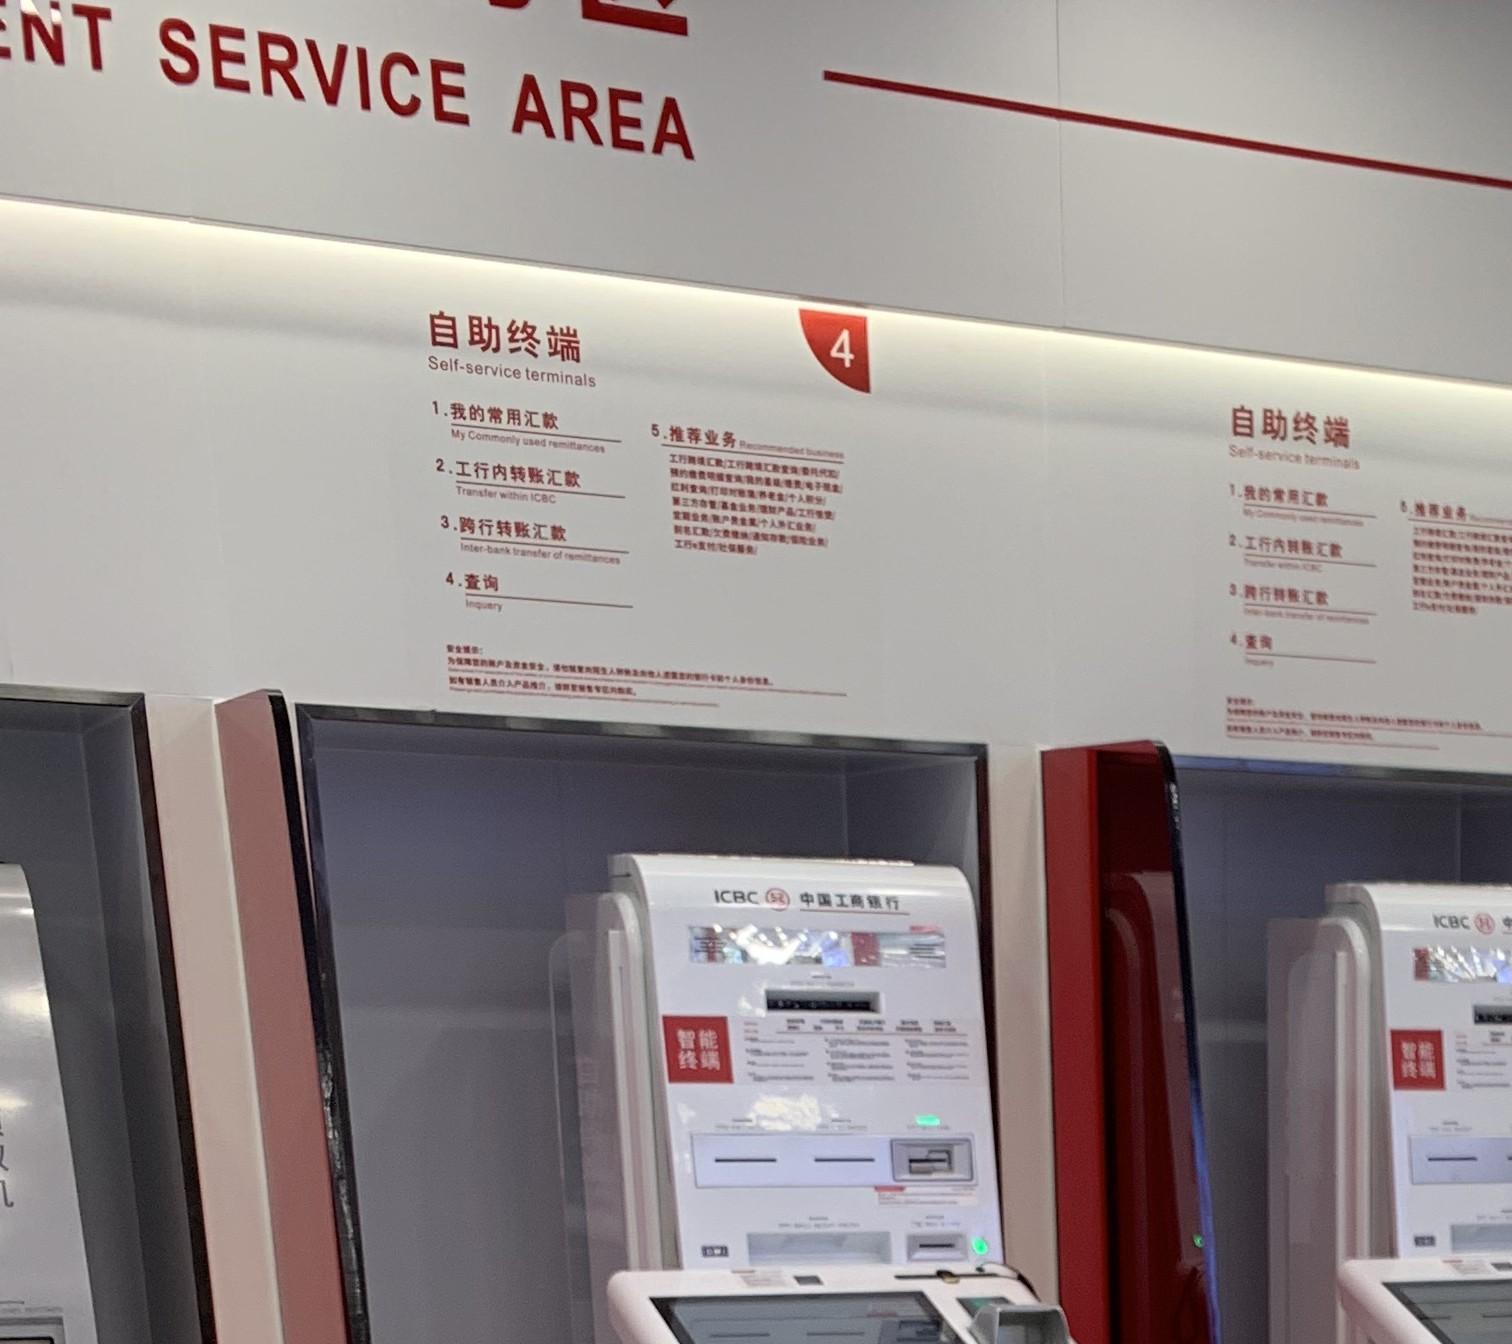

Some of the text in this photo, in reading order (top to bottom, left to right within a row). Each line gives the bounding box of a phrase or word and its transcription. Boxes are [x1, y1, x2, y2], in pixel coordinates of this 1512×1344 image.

[0, 0, 696, 161] NT SERVICE AREA
[429, 310, 582, 363] 自助终端
[829, 328, 856, 369] 4
[428, 355, 597, 387] Self-service terminals
[1231, 404, 1351, 449] 自助终端
[714, 890, 760, 905] ICBC
[800, 891, 900, 911] 中国工商银行
[677, 1028, 719, 1050] 智能
[677, 1049, 721, 1071] 终端
